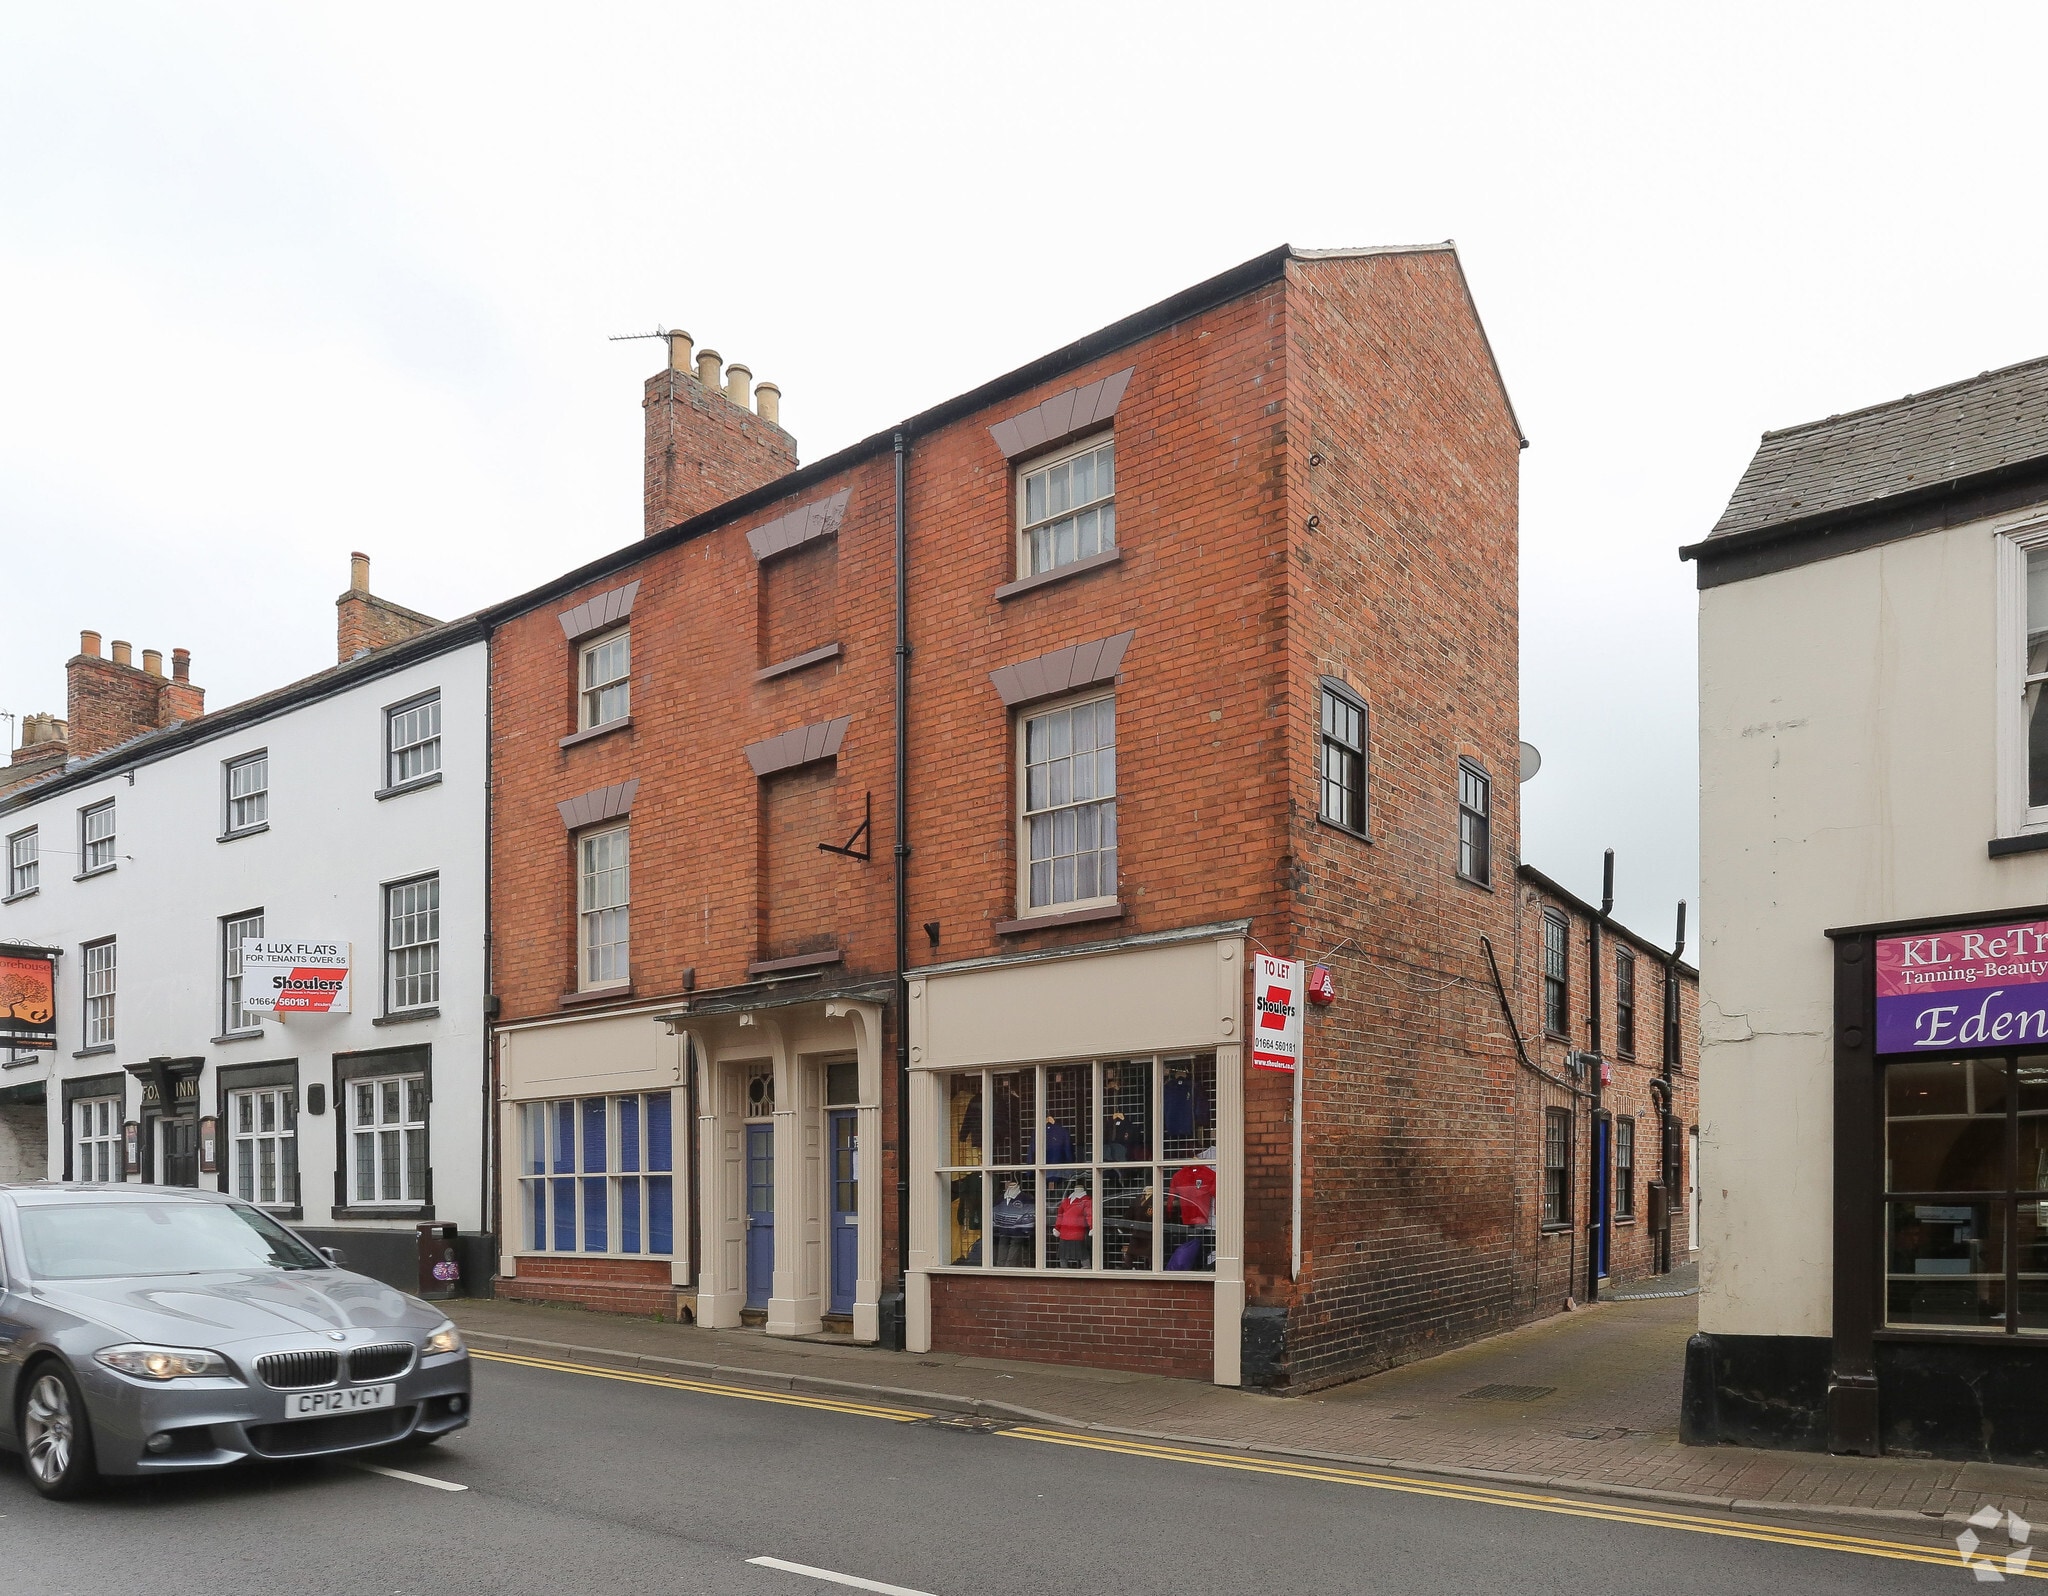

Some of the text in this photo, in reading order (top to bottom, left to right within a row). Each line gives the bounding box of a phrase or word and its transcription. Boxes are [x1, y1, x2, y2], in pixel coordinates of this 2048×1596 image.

[255, 943, 337, 955] 4 LUX FLATS
[1901, 928, 2048, 967] KL ReTr
[266, 955, 307, 963] TENANTS
[309, 956, 333, 964] OVER
[1264, 960, 1290, 979] TO LET
[1901, 960, 2048, 985] Tanning-Beauty
[272, 976, 343, 990] Shoulers
[249, 998, 276, 1006] 01664
[279, 997, 310, 1006] 560181
[1256, 996, 1295, 1017] Shoulers
[1913, 990, 2048, 1046] Eden
[1255, 1037, 1295, 1053] 01664 560181
[142, 1080, 194, 1100] FOX INN
[299, 1387, 384, 1412] CP12 YCY
